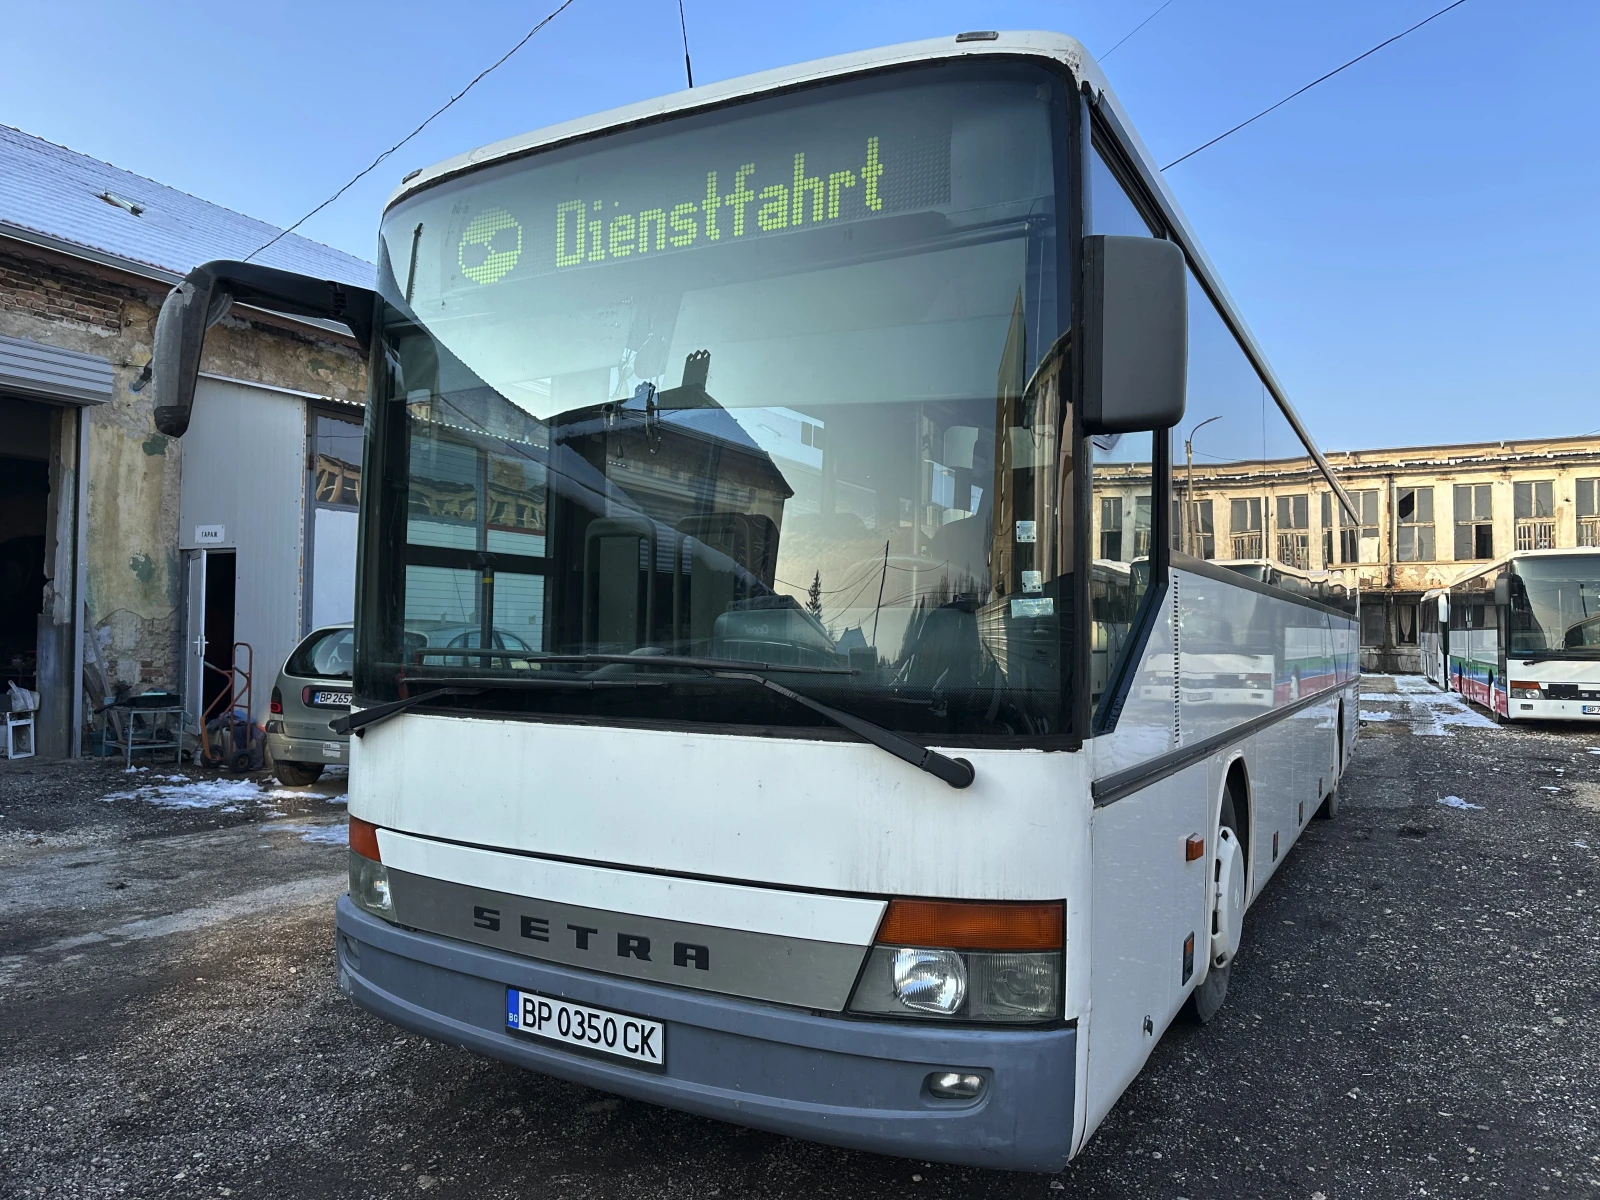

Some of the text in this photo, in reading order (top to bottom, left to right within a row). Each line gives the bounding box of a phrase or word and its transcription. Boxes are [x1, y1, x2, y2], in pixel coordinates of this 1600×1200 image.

[555, 136, 883, 268] Dienstfahrt
[320, 692, 332, 703] BP
[473, 905, 710, 971] SETRA
[508, 1012, 519, 1023] BG
[522, 997, 657, 1059] BP 0350 CK
